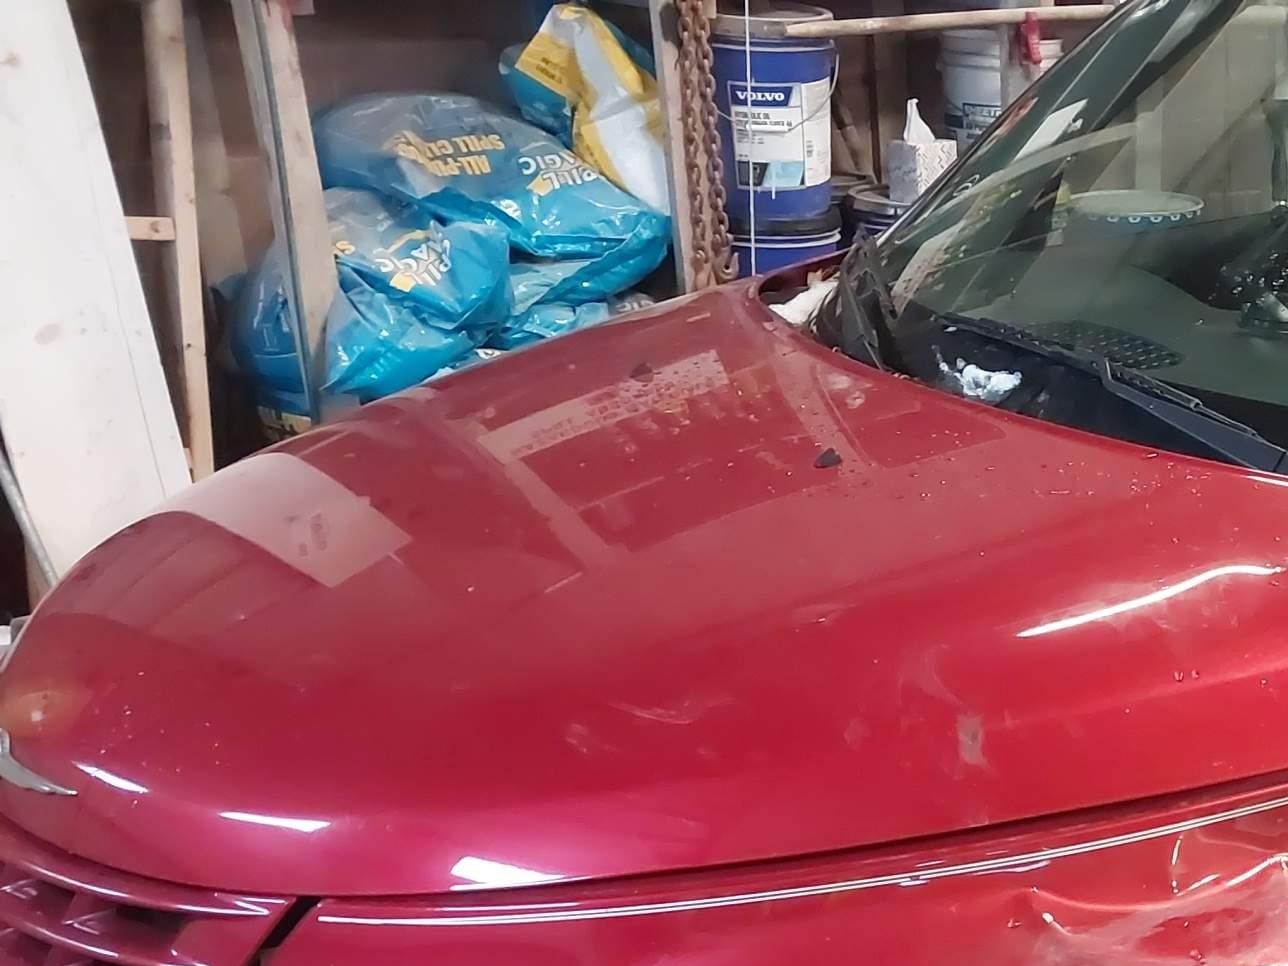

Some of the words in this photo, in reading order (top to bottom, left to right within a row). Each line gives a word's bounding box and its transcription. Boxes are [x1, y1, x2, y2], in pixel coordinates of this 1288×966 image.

[736, 90, 785, 101] VOLVO
[451, 134, 505, 152] SPILL
[543, 166, 599, 190] PILL
